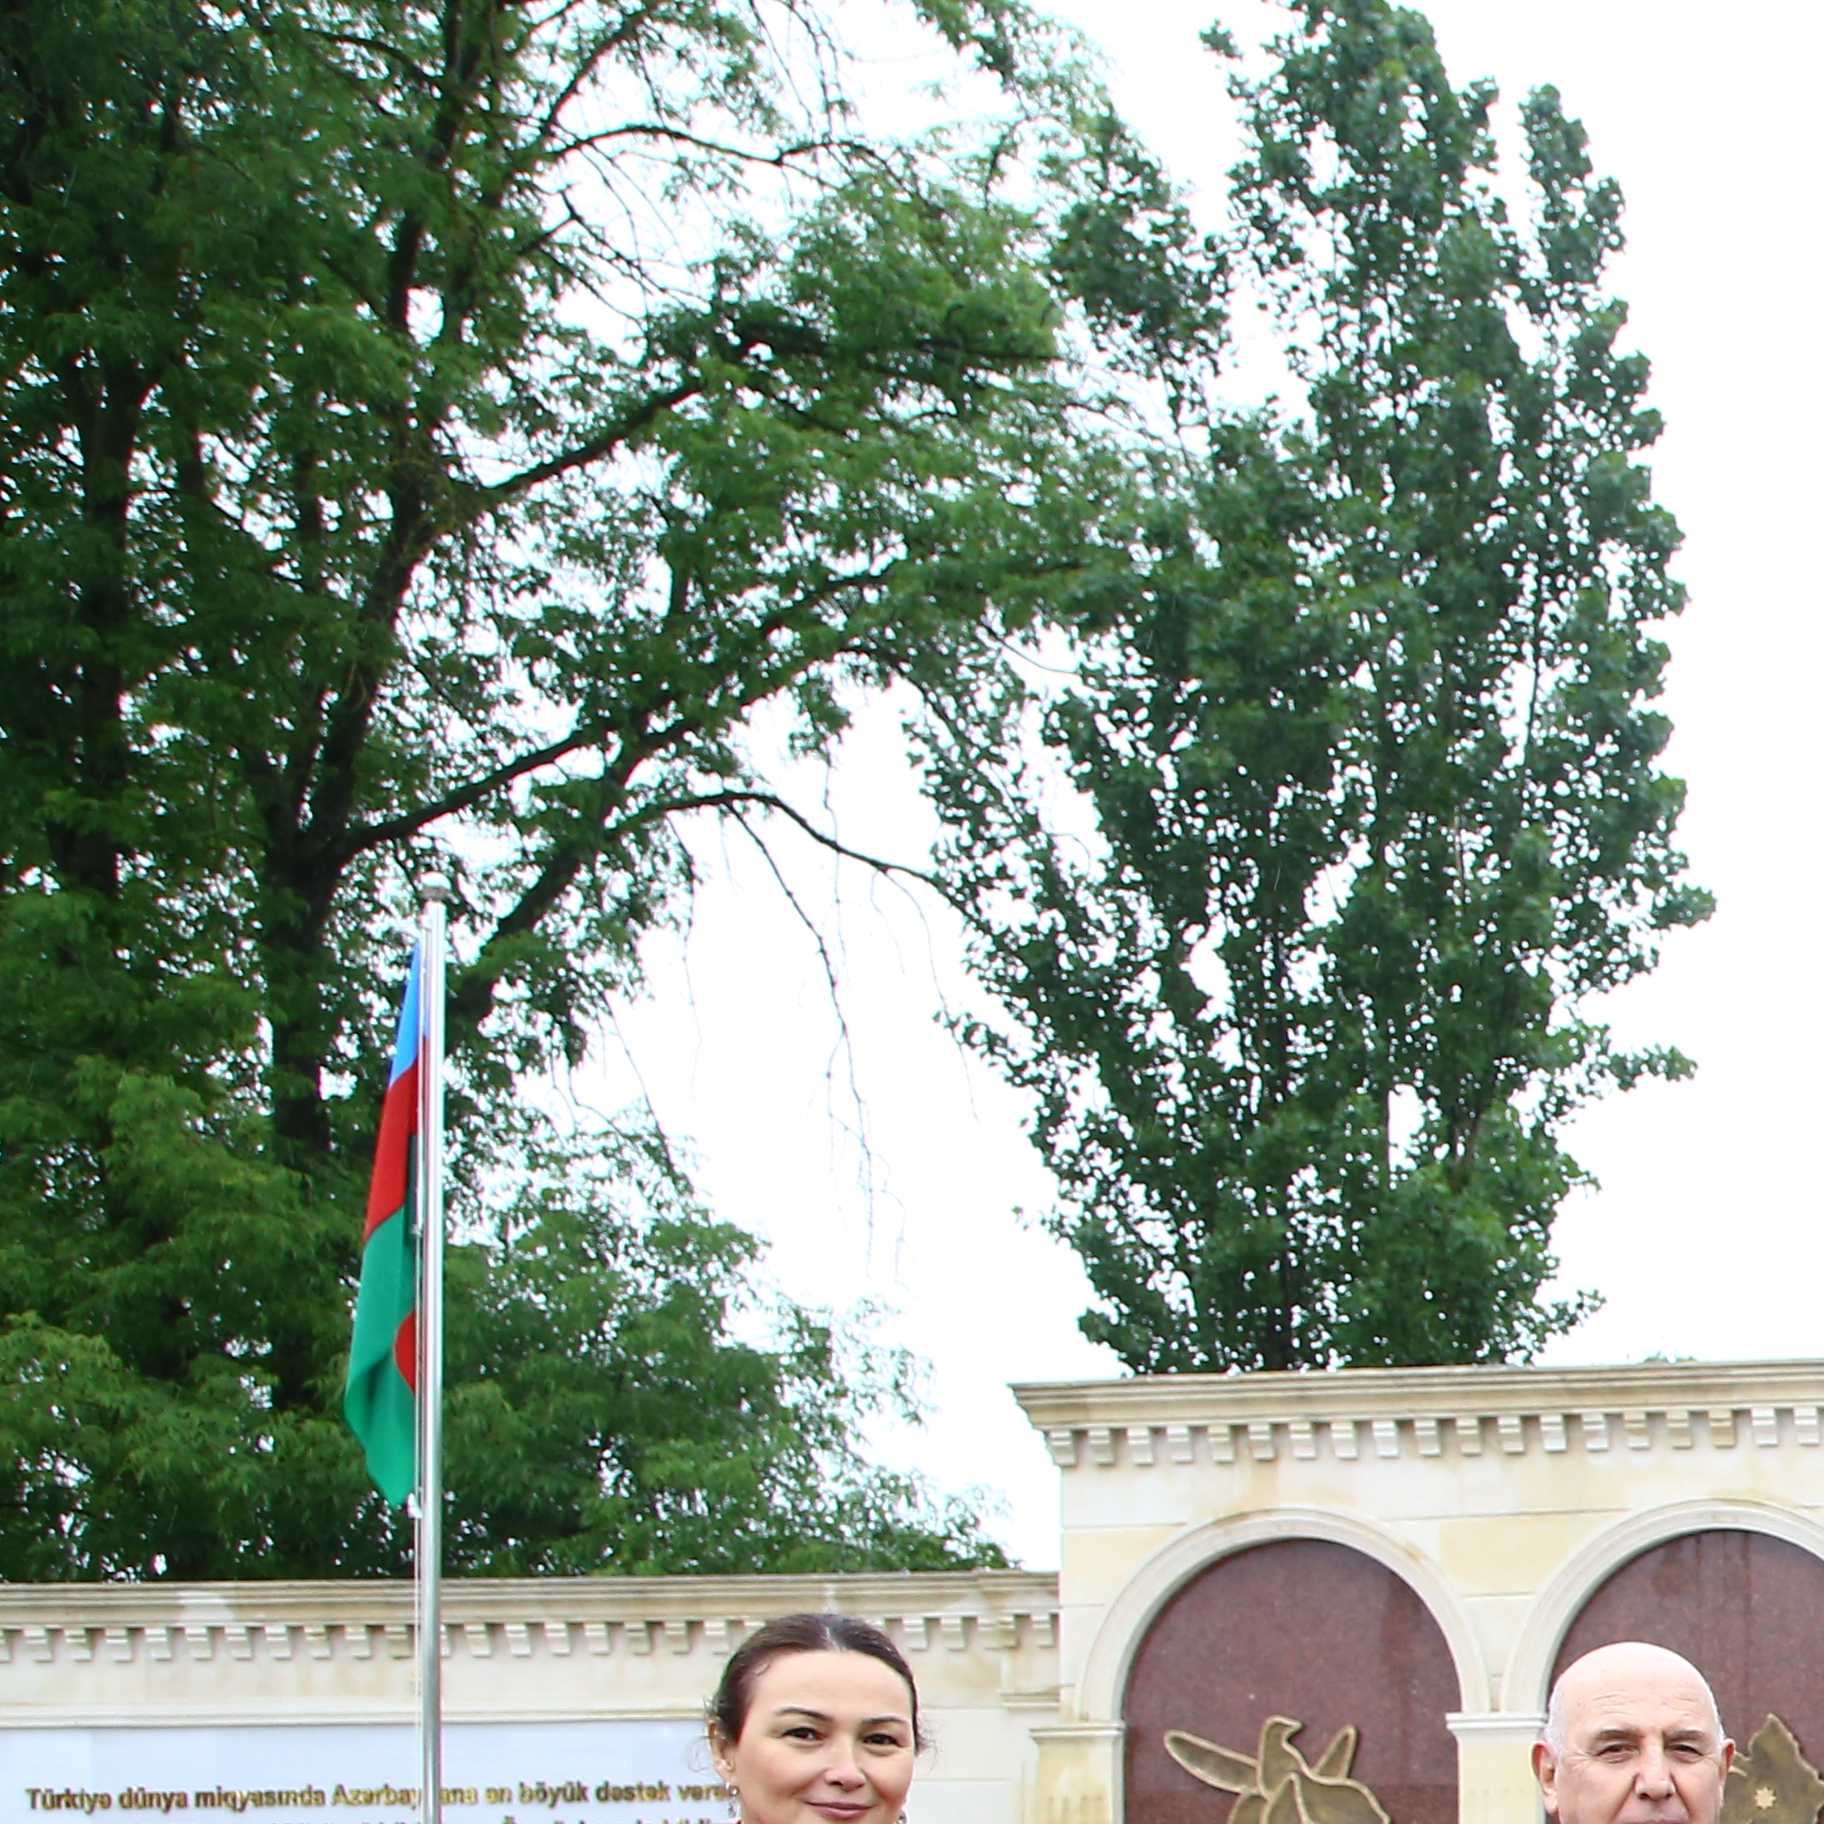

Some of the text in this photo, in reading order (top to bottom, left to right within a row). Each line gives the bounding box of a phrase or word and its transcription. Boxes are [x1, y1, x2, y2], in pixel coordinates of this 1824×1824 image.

[118, 1786, 188, 1814] dünya
[331, 1783, 478, 1811] Azərbayana
[518, 1781, 589, 1809] böyük
